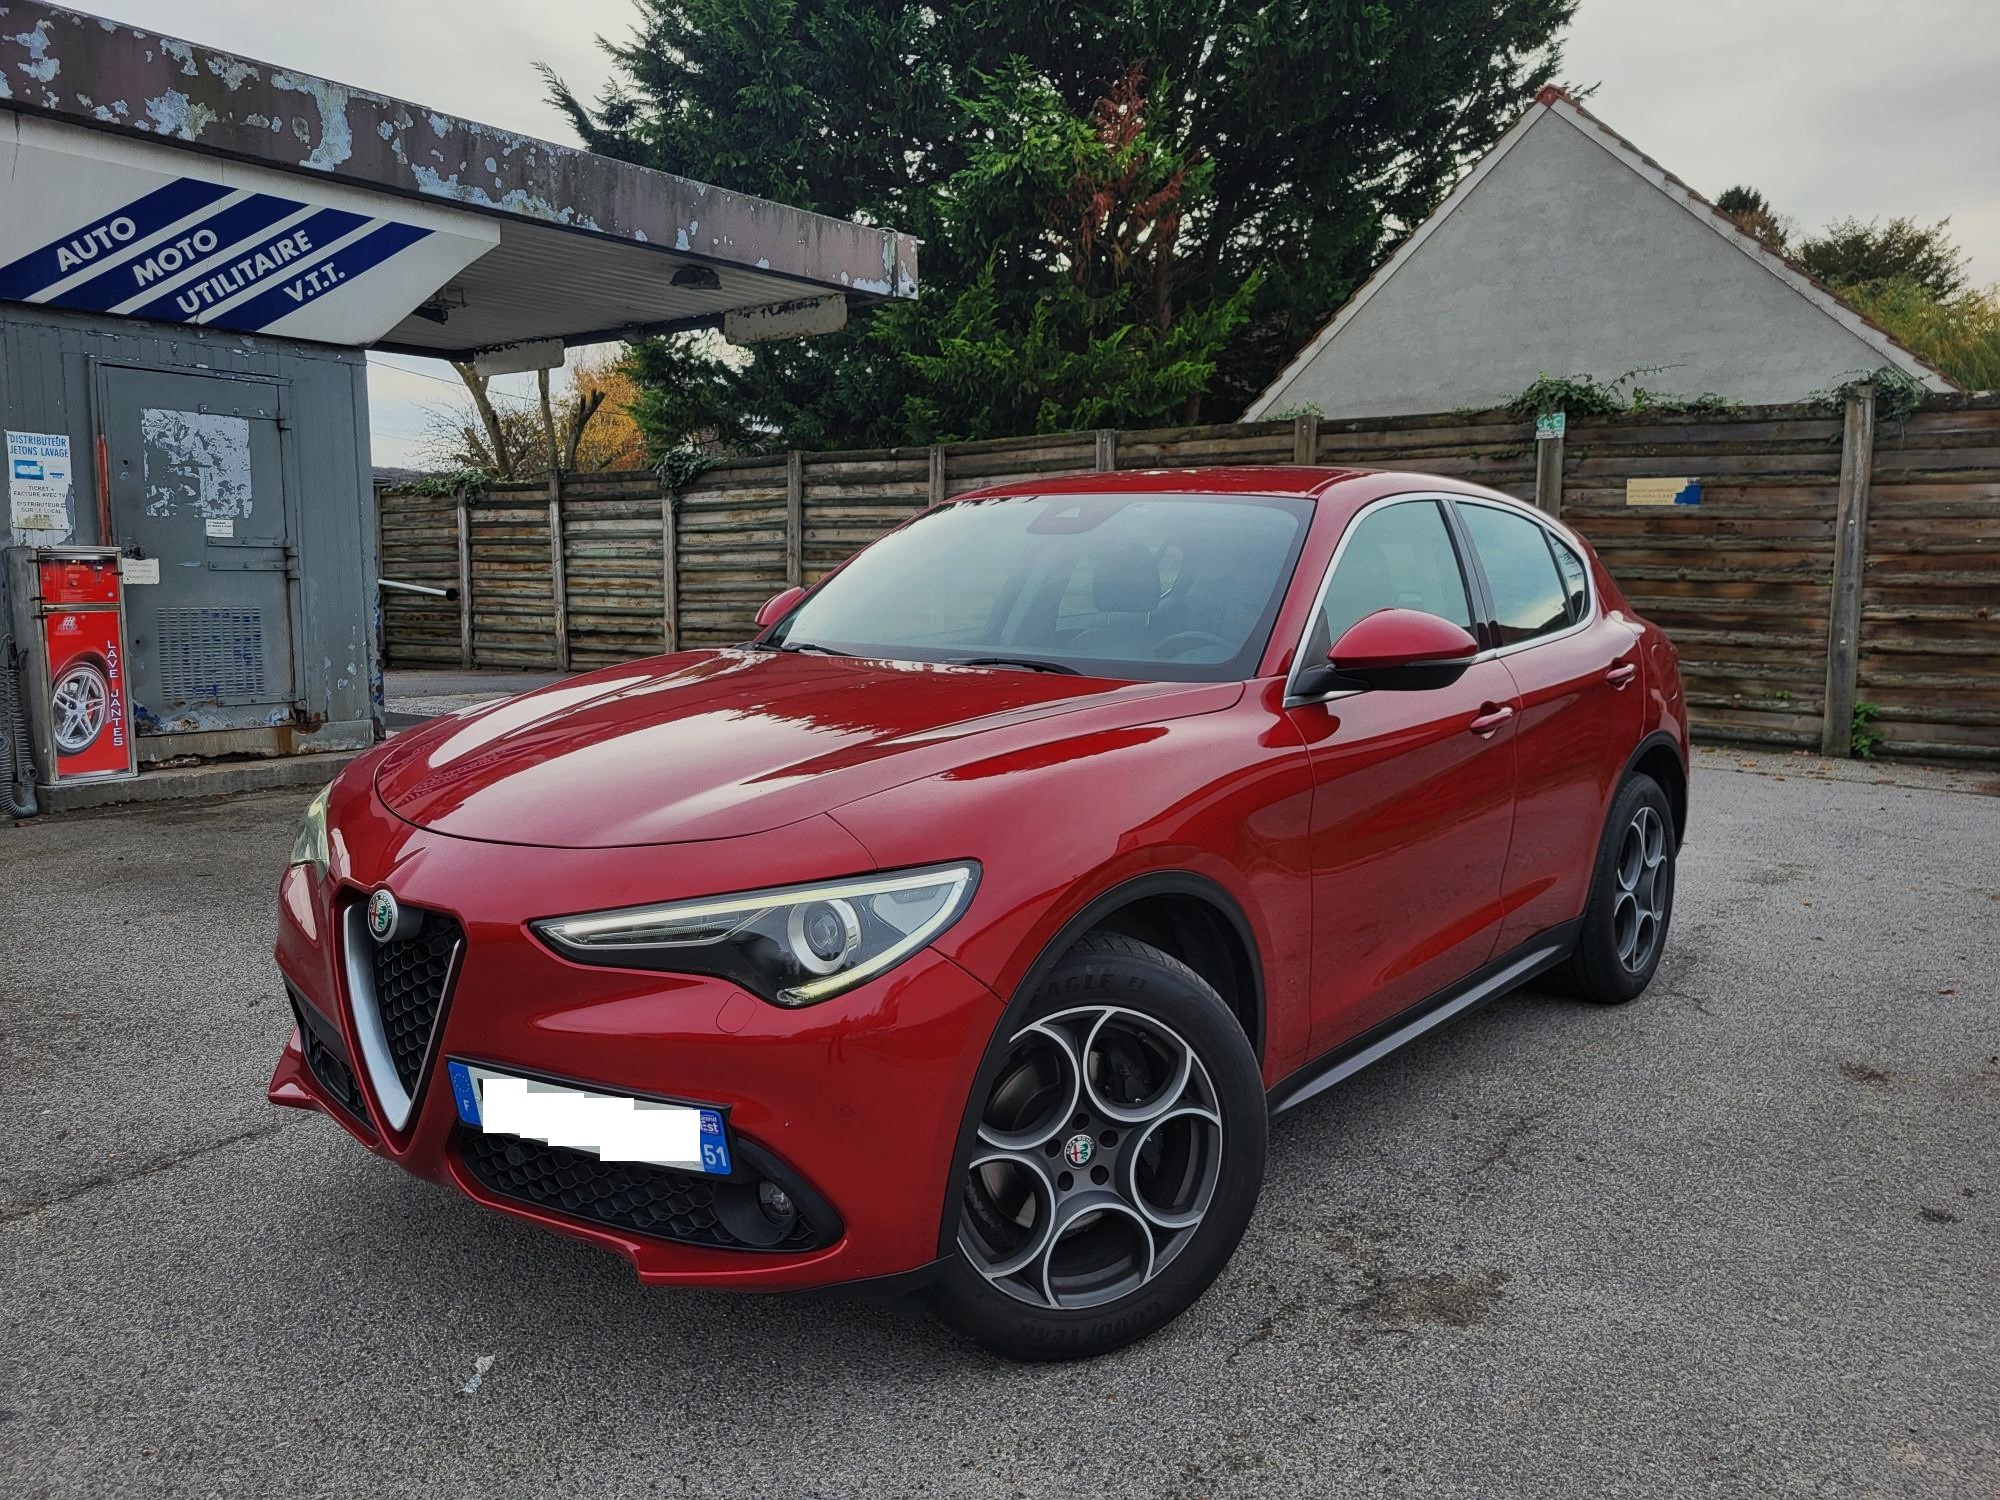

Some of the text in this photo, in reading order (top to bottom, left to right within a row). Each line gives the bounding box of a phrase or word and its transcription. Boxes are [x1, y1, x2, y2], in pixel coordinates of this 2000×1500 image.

[56, 216, 137, 273] AUTO
[132, 229, 218, 288] MOTO
[175, 229, 314, 316] UTILITAIRE
[283, 261, 347, 303] V.T.T.
[10, 434, 66, 447] DISTRIBUTEUR
[10, 445, 68, 457] JETONS LAVAGE
[107, 639, 123, 747] LAVE JANTES
[463, 1099, 470, 1112] F
[703, 1143, 727, 1167] 51
